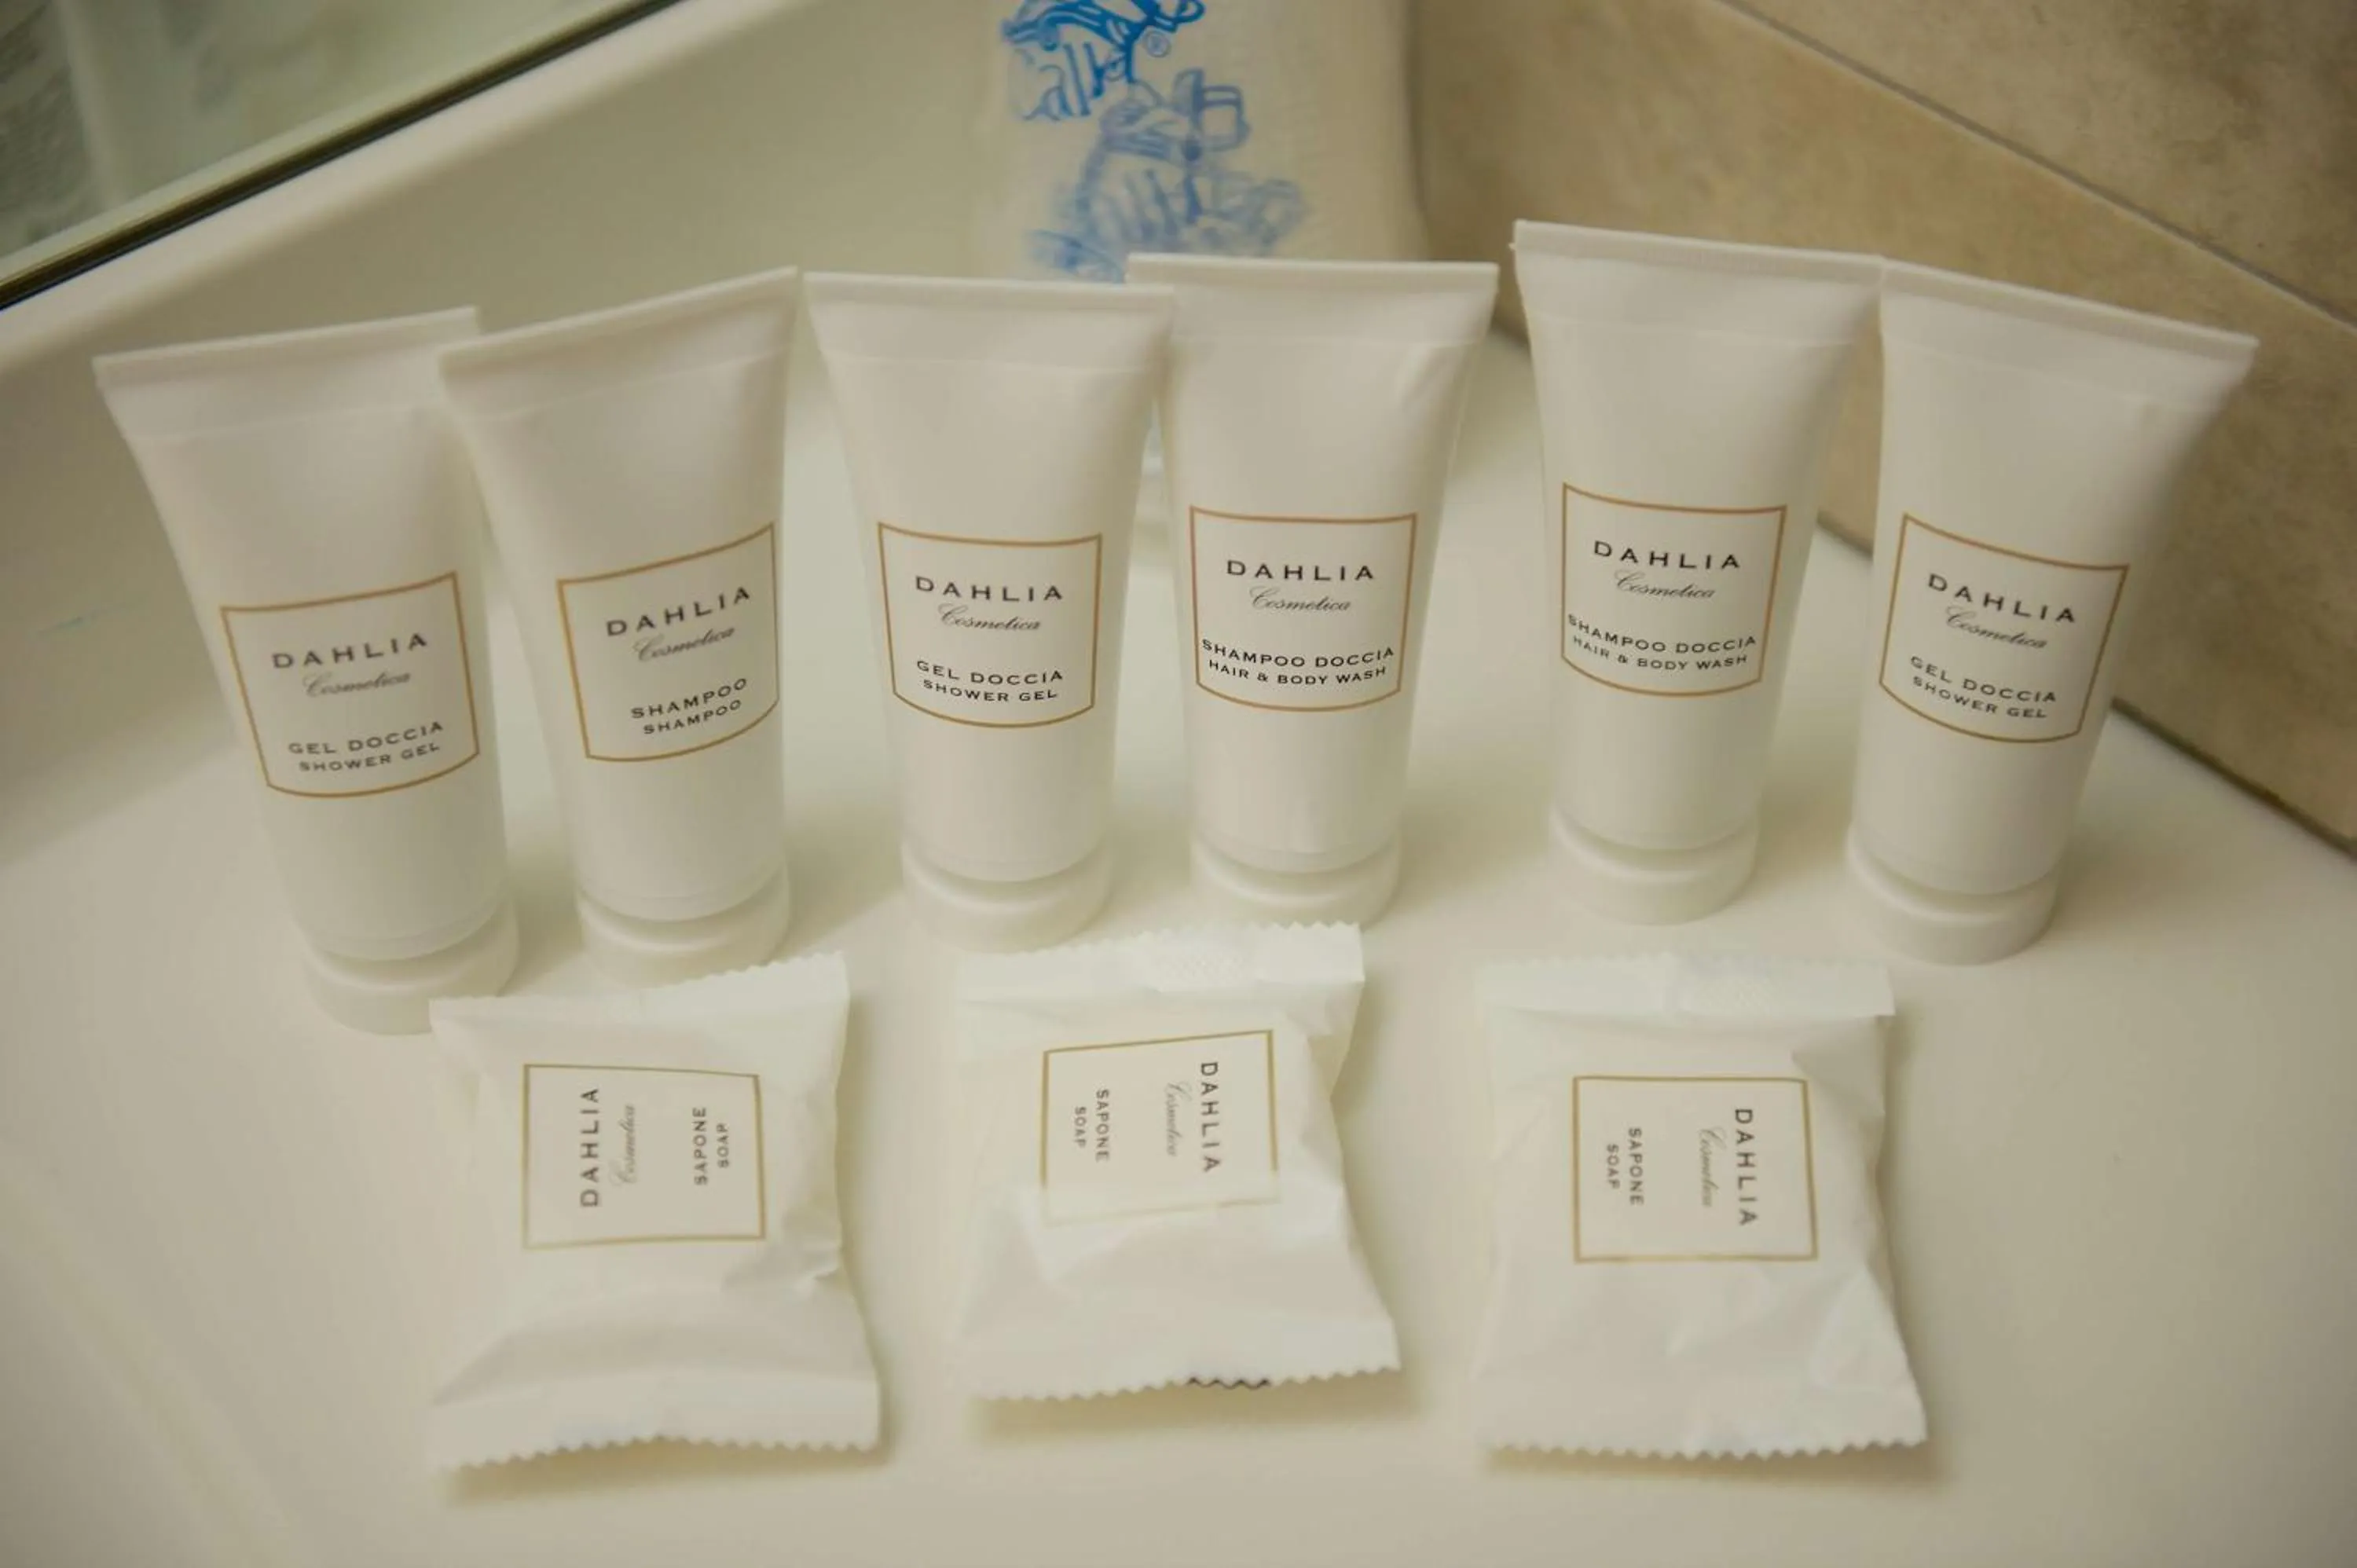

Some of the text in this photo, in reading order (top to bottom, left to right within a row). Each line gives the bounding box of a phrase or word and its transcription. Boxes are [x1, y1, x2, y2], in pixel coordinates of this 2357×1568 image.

[1226, 560, 1373, 581] DAHLIA
[1593, 540, 1740, 570] DAHLIA
[915, 576, 1063, 602] DAHLIA
[1249, 587, 1351, 613] Cosmetica
[1613, 570, 1717, 600] Cosmetica
[1928, 574, 2076, 624] DAHLIA
[606, 586, 750, 638] DAHLIA
[939, 603, 1040, 631] Cosmetica
[1945, 605, 2047, 648] Cosmetica
[273, 633, 427, 669] DAHLIA
[632, 625, 735, 663] Cosmetica
[1567, 614, 1756, 653] SHAMPOO DOCCIA
[1201, 639, 1395, 668] SHAMPOO DOCCIA
[1572, 636, 1747, 671] HAIR & BODY WASH
[302, 671, 410, 698] Cosmetica
[917, 661, 1064, 686] GEL DOCCIA
[923, 680, 1058, 702] SHOWER GEL
[1208, 660, 1386, 686] HAIR & BODY WASH
[1910, 656, 2057, 704] GEL DOCCIA
[631, 678, 748, 720] SHAMPOO
[1913, 676, 2047, 719] SHOWER GEL
[643, 700, 742, 735] SHAMPOO
[288, 721, 444, 755] GEL DOCCIA
[299, 743, 440, 772] SHOWER GEL
[1074, 1107, 1087, 1148] SOAP
[1095, 1090, 1109, 1162] SAPONE
[1200, 1062, 1221, 1172] DAHLIA
[580, 1089, 599, 1207] DAHLIA
[693, 1108, 707, 1185] SAPONE
[717, 1123, 729, 1167] SOAP
[1607, 1145, 1620, 1189] SOAP
[1629, 1128, 1644, 1205] SAPONE
[1735, 1109, 1758, 1225] DAHLIA
